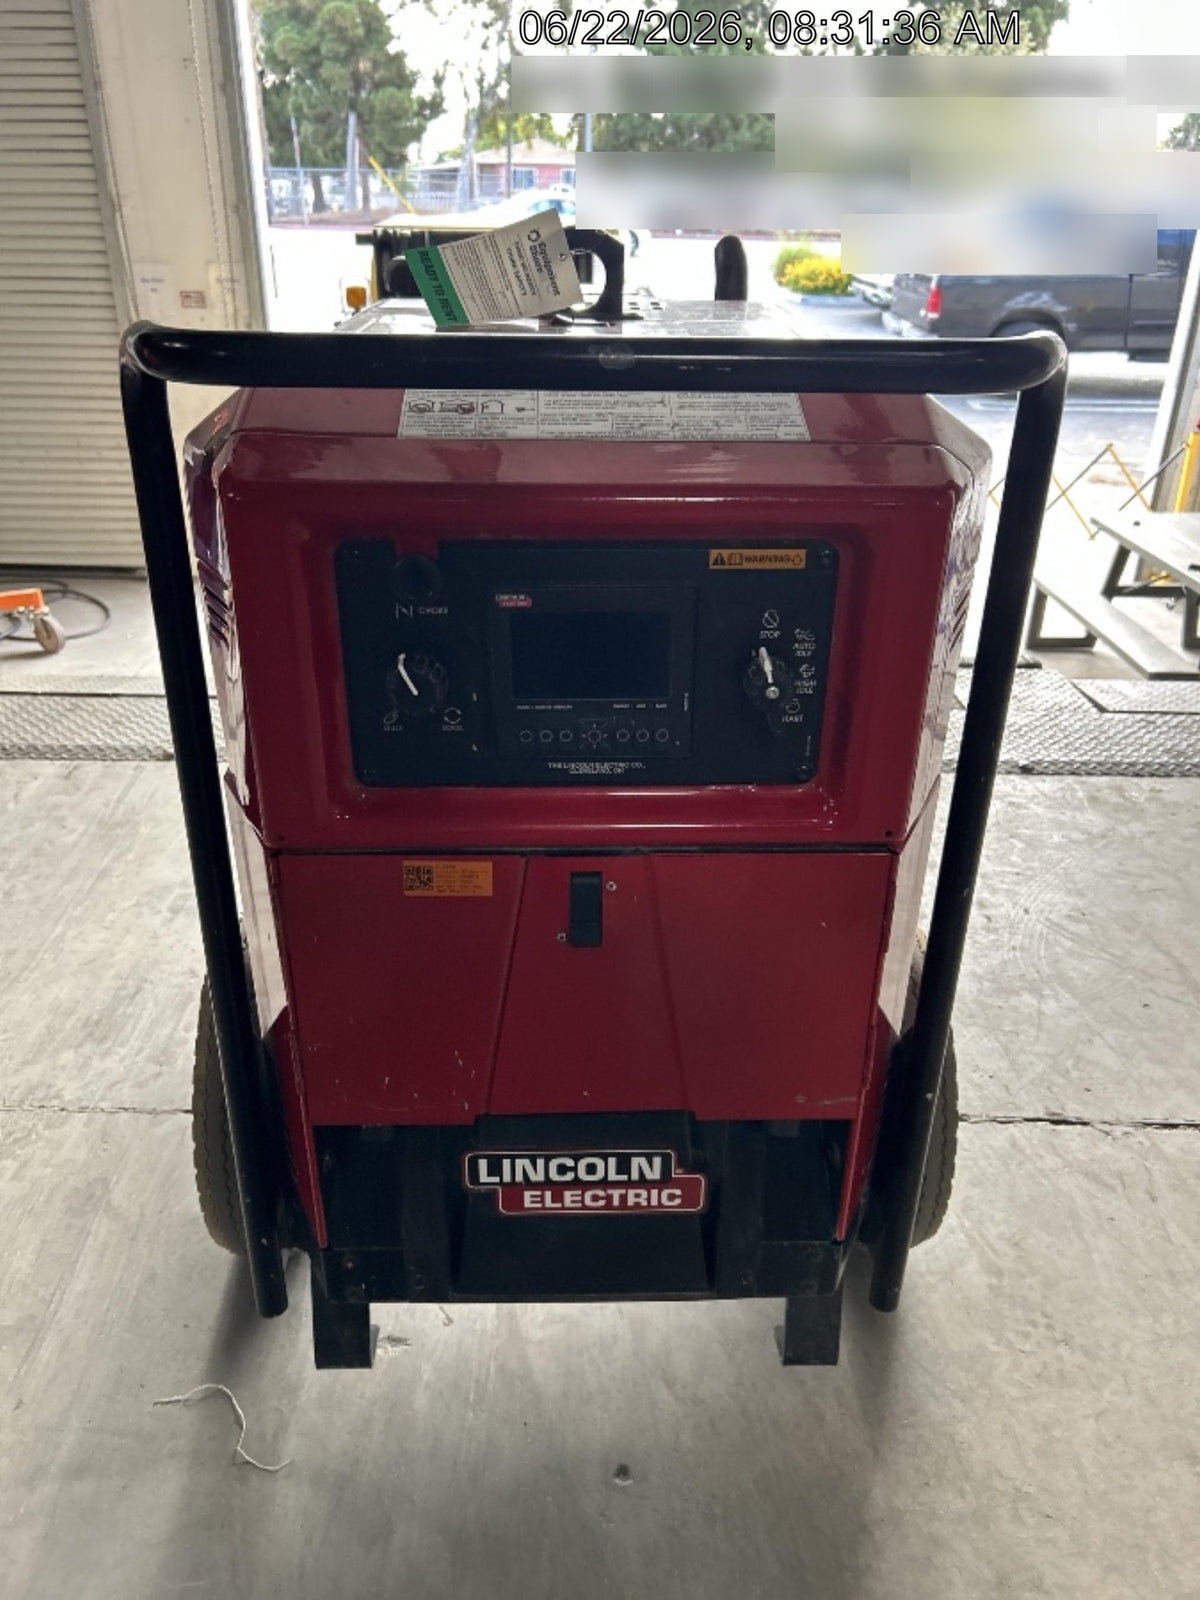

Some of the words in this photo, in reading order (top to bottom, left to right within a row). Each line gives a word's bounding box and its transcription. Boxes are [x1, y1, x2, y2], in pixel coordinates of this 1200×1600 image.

[417, 250, 438, 282] READY
[431, 281, 446, 296] TO
[439, 295, 459, 322] RENT
[744, 554, 791, 565] WARNING
[759, 630, 781, 640] STOP
[478, 1156, 662, 1183] LINCOLN
[524, 1188, 682, 1208] ELECTRIC
